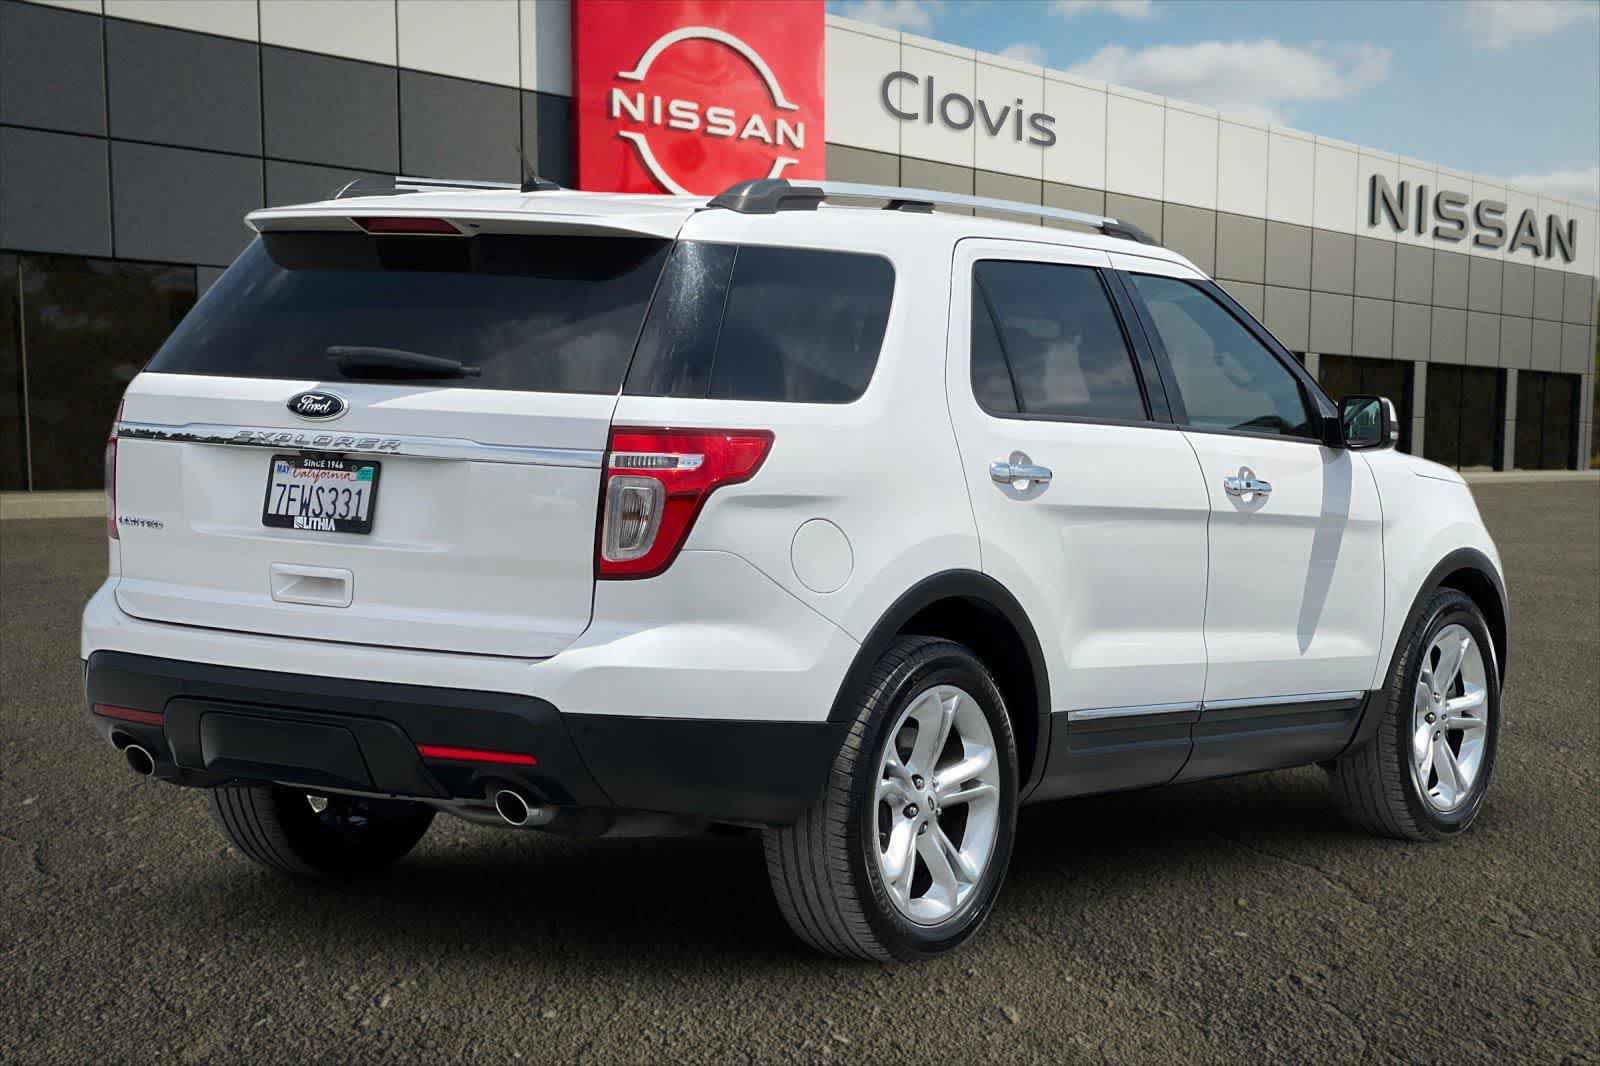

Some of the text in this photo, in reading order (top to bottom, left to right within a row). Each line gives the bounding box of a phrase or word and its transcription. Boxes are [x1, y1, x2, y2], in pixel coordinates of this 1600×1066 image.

[610, 87, 806, 149] NISSAN
[880, 70, 1058, 147] Clovis
[1368, 173, 1578, 263] NISSAN
[297, 393, 331, 414] Ford
[232, 430, 401, 450] EXPLORER
[304, 459, 325, 468] SINCE
[275, 483, 363, 519] 7FWS331
